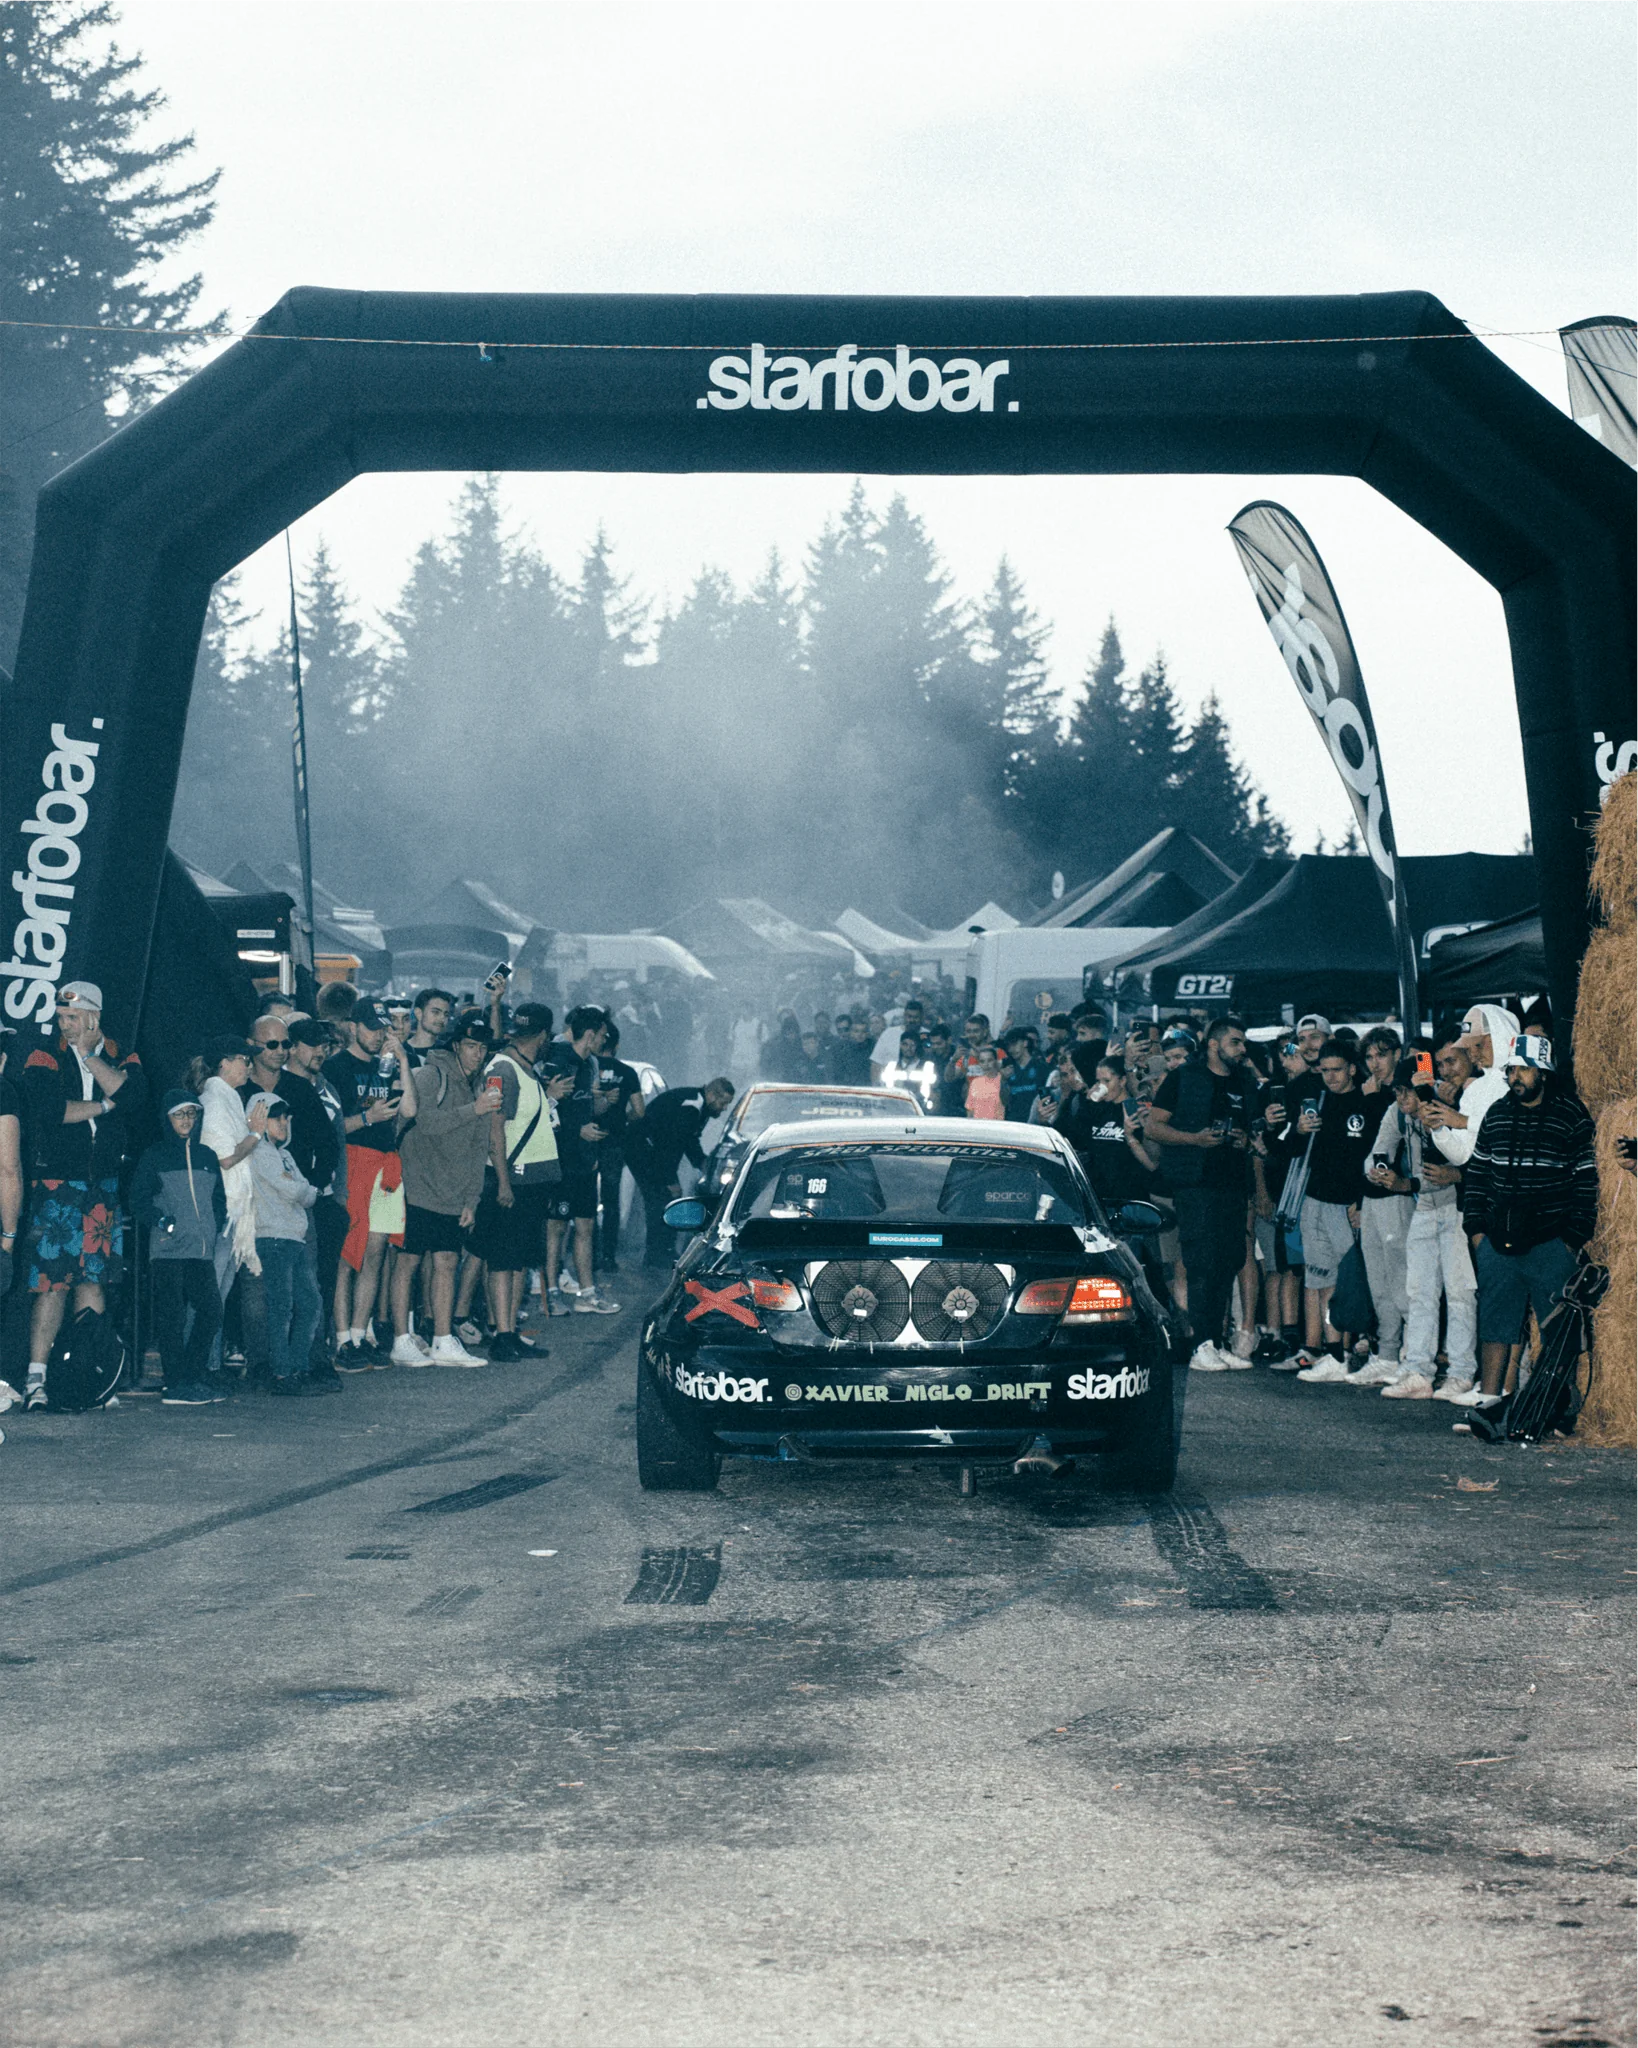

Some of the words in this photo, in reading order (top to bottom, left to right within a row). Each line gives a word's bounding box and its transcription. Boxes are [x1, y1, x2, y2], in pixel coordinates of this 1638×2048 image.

[1178, 974, 1234, 995] GT2i
[877, 1145, 1017, 1158] SPECIALTIES
[807, 1178, 827, 1194] 166
